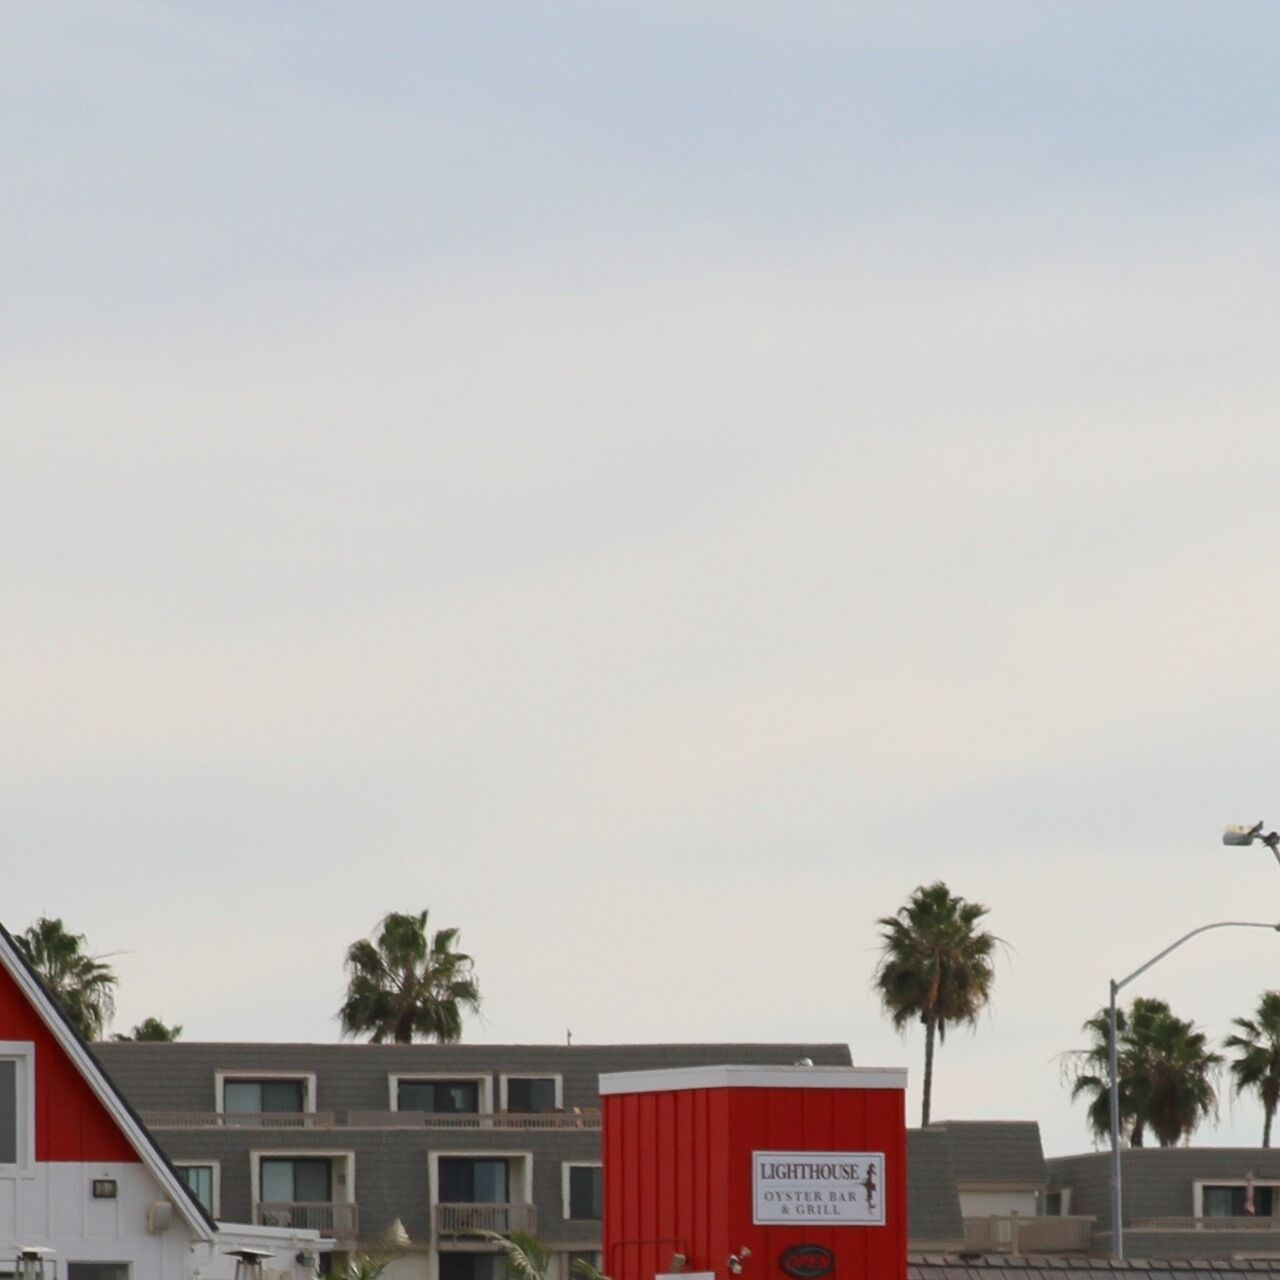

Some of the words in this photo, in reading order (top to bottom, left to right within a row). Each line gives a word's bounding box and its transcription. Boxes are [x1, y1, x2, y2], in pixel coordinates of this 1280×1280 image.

[761, 1163, 859, 1181] LIGHTHOUSE
[764, 1191, 823, 1202] OYSTER
[829, 1191, 857, 1202] BAR
[781, 1204, 790, 1215] &
[796, 1204, 841, 1216] GRILL
